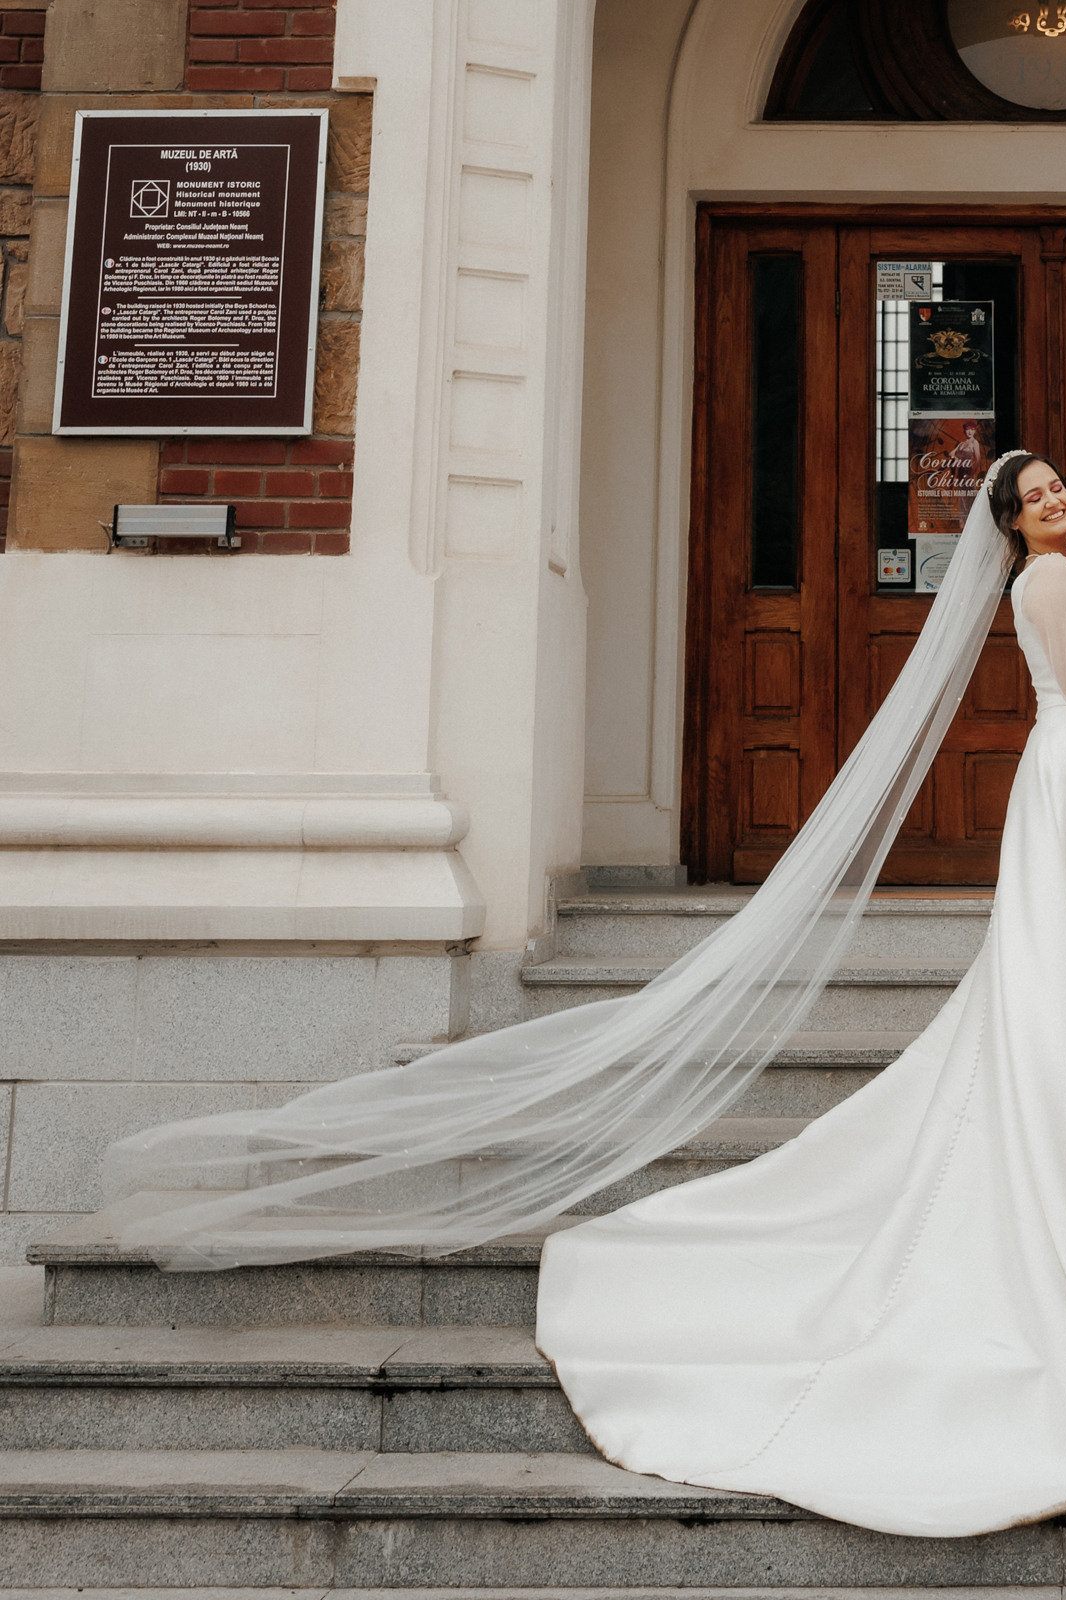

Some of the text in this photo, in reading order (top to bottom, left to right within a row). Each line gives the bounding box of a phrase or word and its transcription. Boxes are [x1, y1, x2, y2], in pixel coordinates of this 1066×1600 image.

[160, 148, 238, 159] MUZEUL DE ARTĂ
[185, 161, 211, 173] (1930)
[219, 201, 260, 209] historique
[877, 263, 900, 271] SISTEM
[914, 451, 972, 470] Corina
[921, 470, 984, 489] Chiriac
